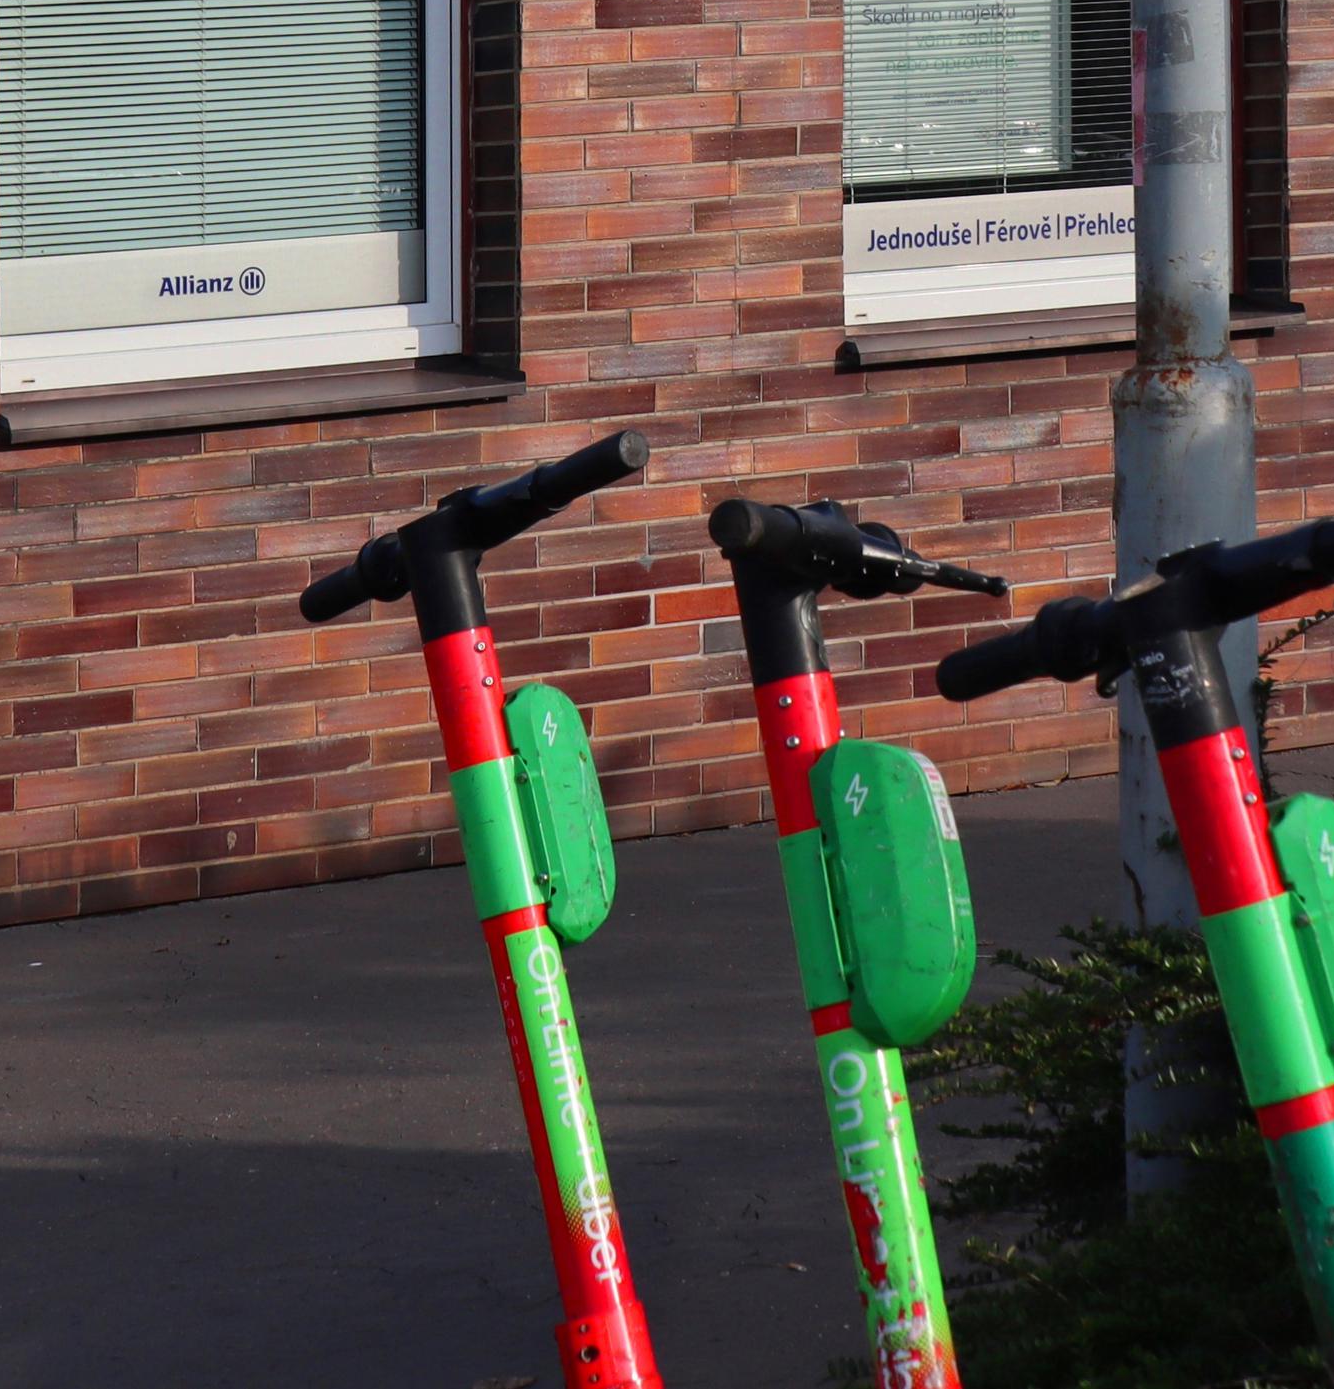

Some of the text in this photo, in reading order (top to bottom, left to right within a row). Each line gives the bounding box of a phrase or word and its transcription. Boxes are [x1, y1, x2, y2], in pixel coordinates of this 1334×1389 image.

[868, 222, 971, 252] Jednoduše
[985, 216, 1051, 243] Férově
[159, 270, 234, 297] Allianz
[528, 945, 561, 1014] On
[543, 1020, 587, 1128] Lime
[829, 1052, 867, 1132] On
[577, 1172, 622, 1284] Uber
